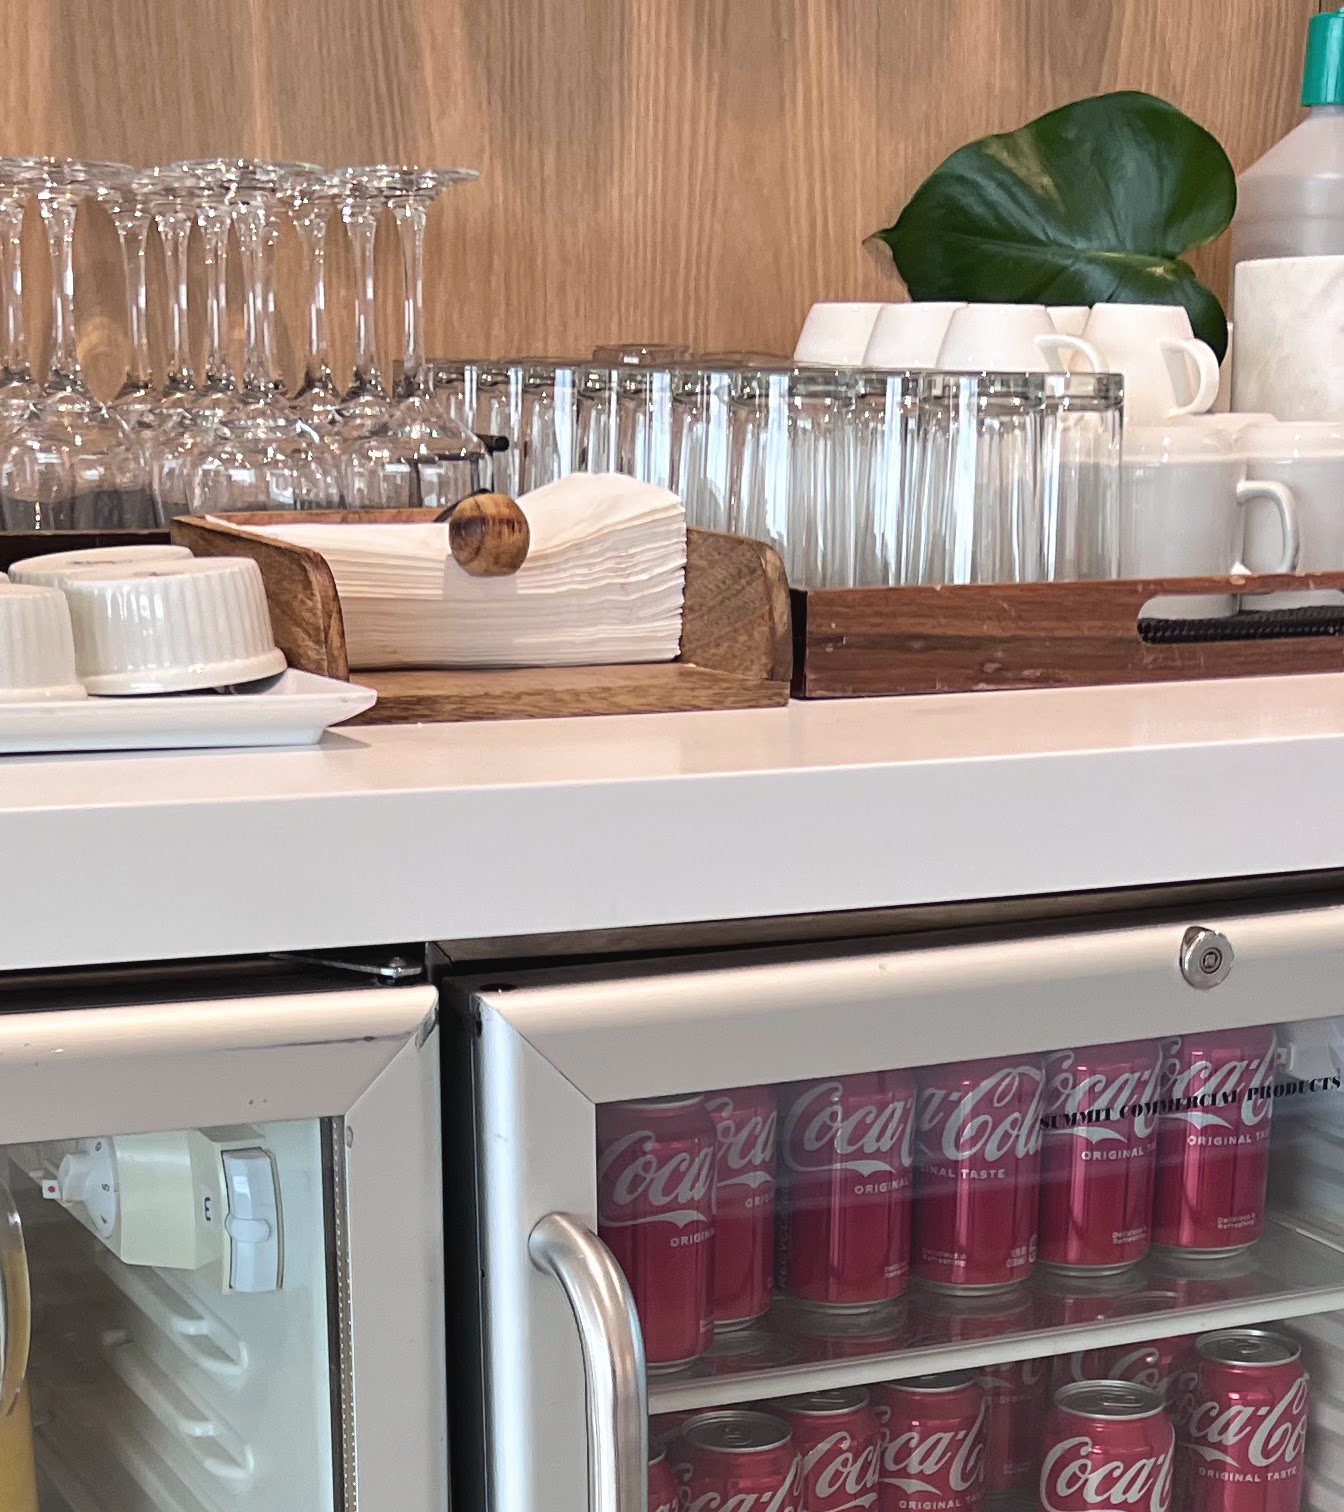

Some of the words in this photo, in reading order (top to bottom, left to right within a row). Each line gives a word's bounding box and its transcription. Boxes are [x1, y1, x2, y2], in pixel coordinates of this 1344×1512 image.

[1040, 1108, 1114, 1131] SUMMIT
[1119, 1089, 1240, 1120] COMMERCIAL
[1247, 1075, 1342, 1102] PRODUCTS
[1187, 1133, 1252, 1146] ORIGINAL
[1082, 1146, 1144, 1161] ORIGINAL
[961, 1168, 1006, 1180] TASTE
[1198, 1466, 1261, 1483] ORIGINAL
[1266, 1467, 1297, 1481] TASTE
[899, 1500, 961, 1511] ORIGINAL
